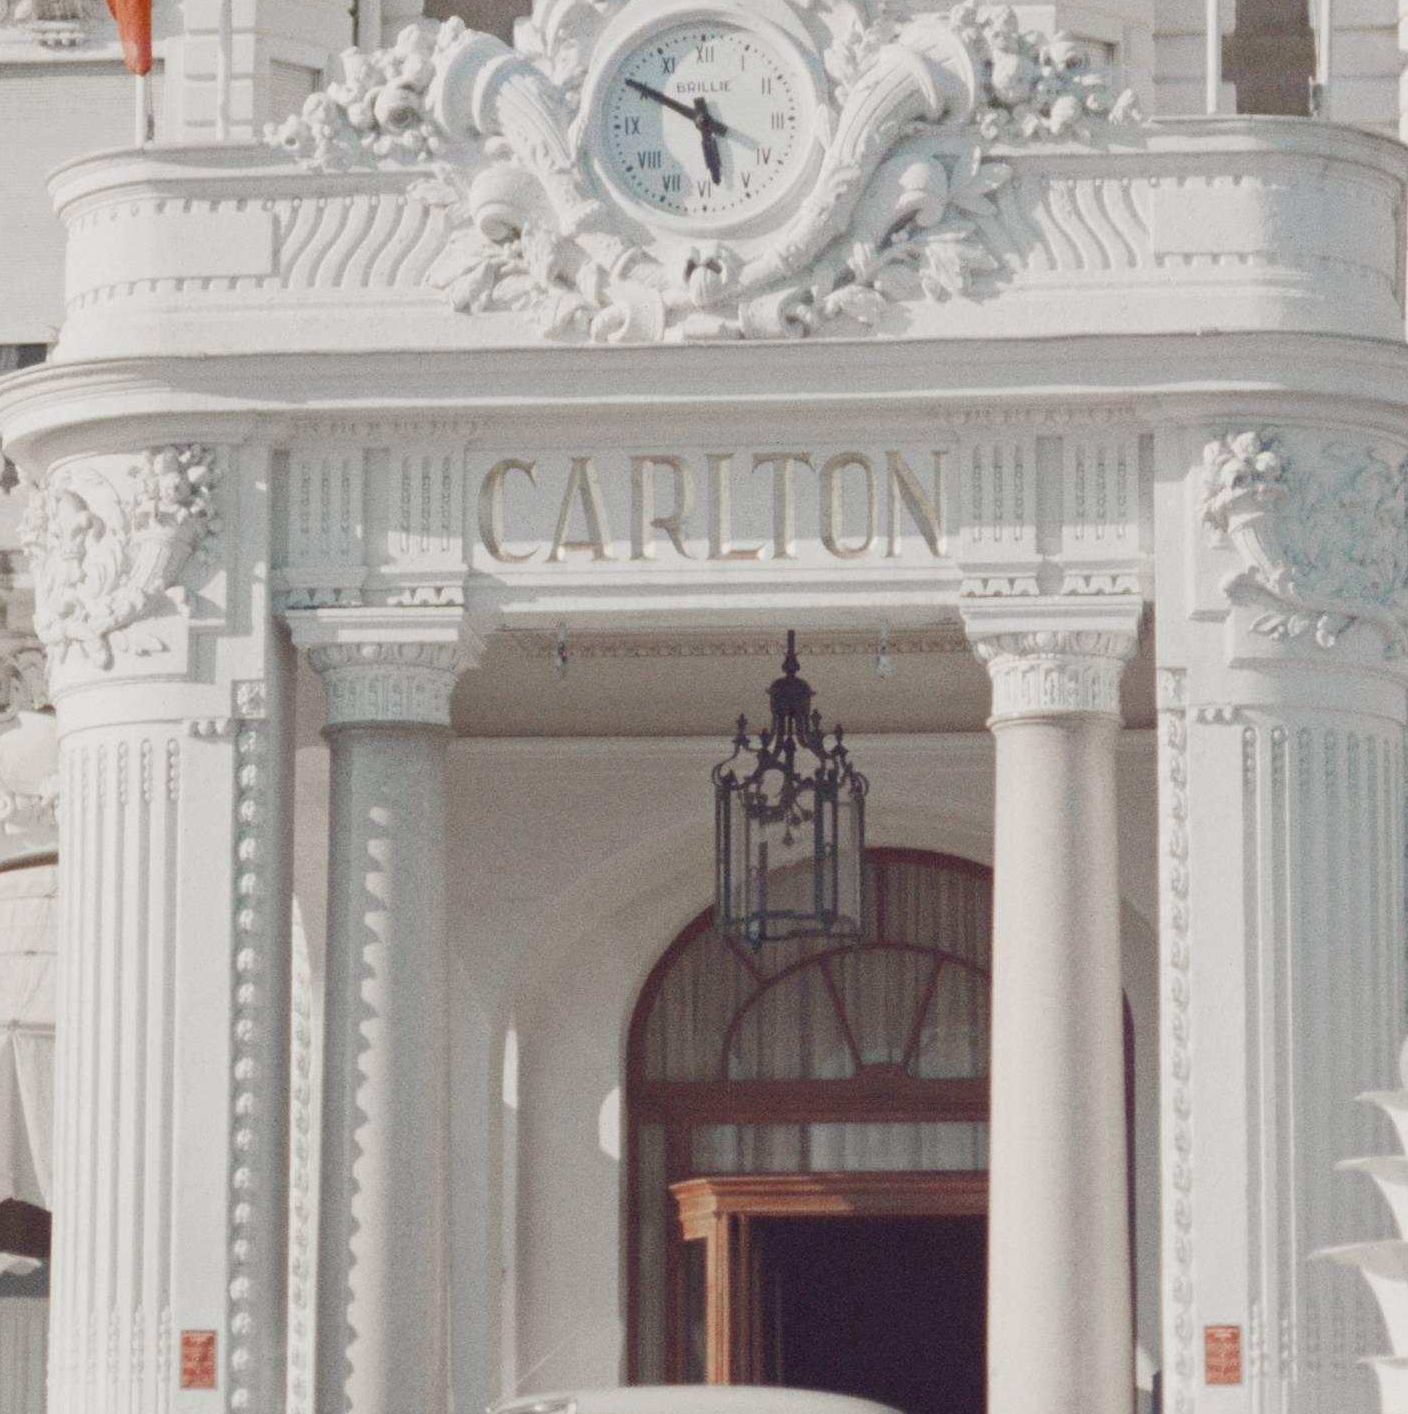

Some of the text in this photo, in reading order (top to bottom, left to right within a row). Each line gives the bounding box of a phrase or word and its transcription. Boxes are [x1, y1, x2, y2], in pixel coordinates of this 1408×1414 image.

[696, 46, 714, 63] XII
[662, 57, 675, 74] XI
[676, 81, 732, 94] BRILLIE
[761, 78, 771, 95] II
[625, 116, 640, 134] IX
[771, 112, 784, 130] III
[637, 151, 662, 169] VIII
[756, 147, 771, 164] IV
[662, 175, 680, 192] VII
[741, 172, 751, 189] V
[698, 181, 711, 198] VI
[478, 450, 951, 564] CARLTON
